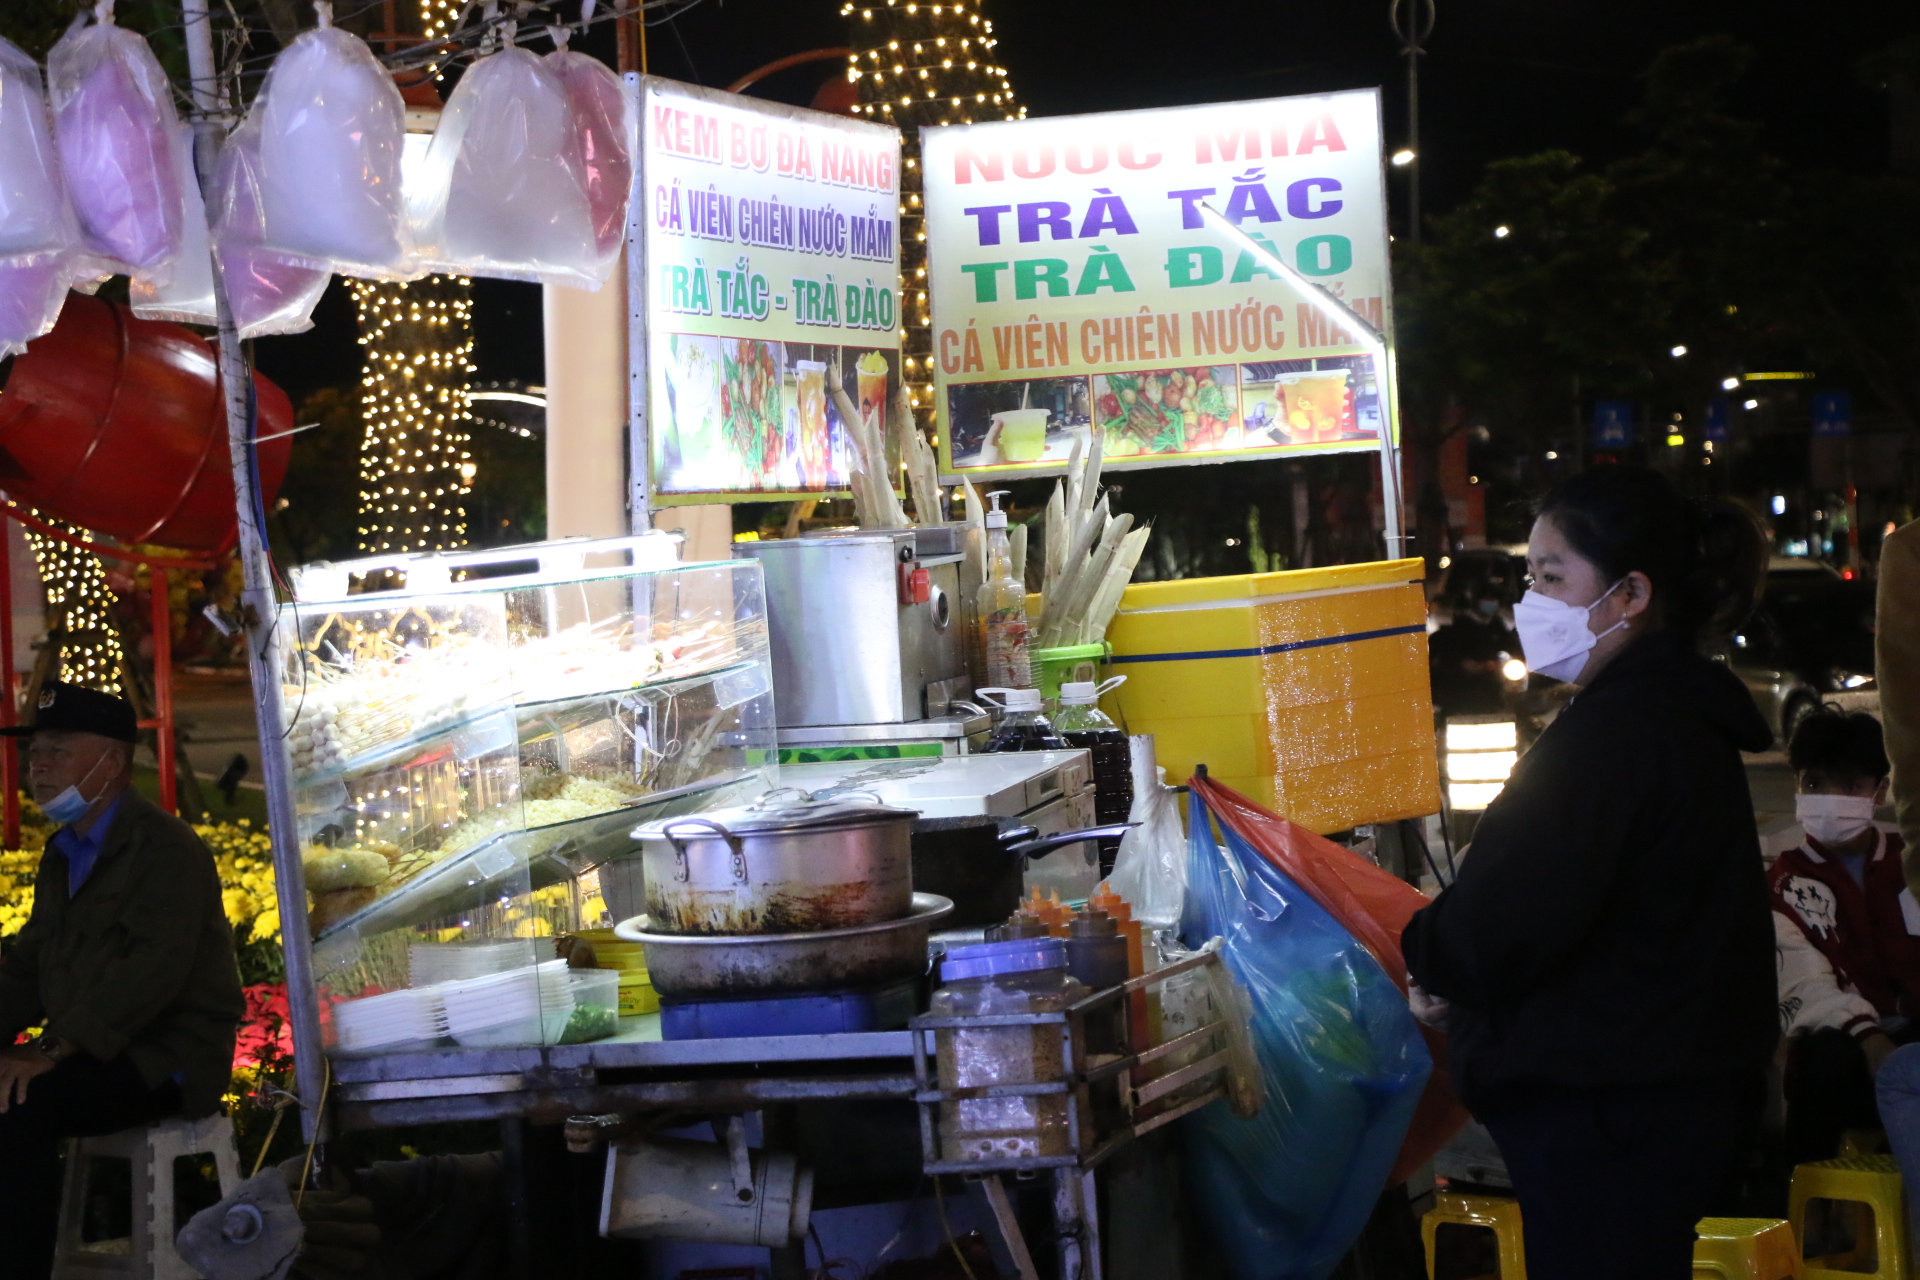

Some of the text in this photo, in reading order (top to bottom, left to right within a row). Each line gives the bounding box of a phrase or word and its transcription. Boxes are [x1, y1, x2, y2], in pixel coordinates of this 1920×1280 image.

[654, 105, 720, 161] KEM
[730, 122, 769, 169] BƠ
[655, 178, 893, 260] CÁ VIÊN CHIÊN NƯỚC MẮM
[964, 167, 1344, 246] TRÀ TẮC
[658, 256, 894, 329] TRÀ TẮC - TRÀ ĐÀO
[961, 231, 1353, 303] TRÀ ĐÀO
[940, 318, 985, 375] CÁ
[993, 313, 1070, 371] VIÊN
[1080, 306, 1181, 365] CHIÊN
[1192, 297, 1285, 355] NƯỚC
